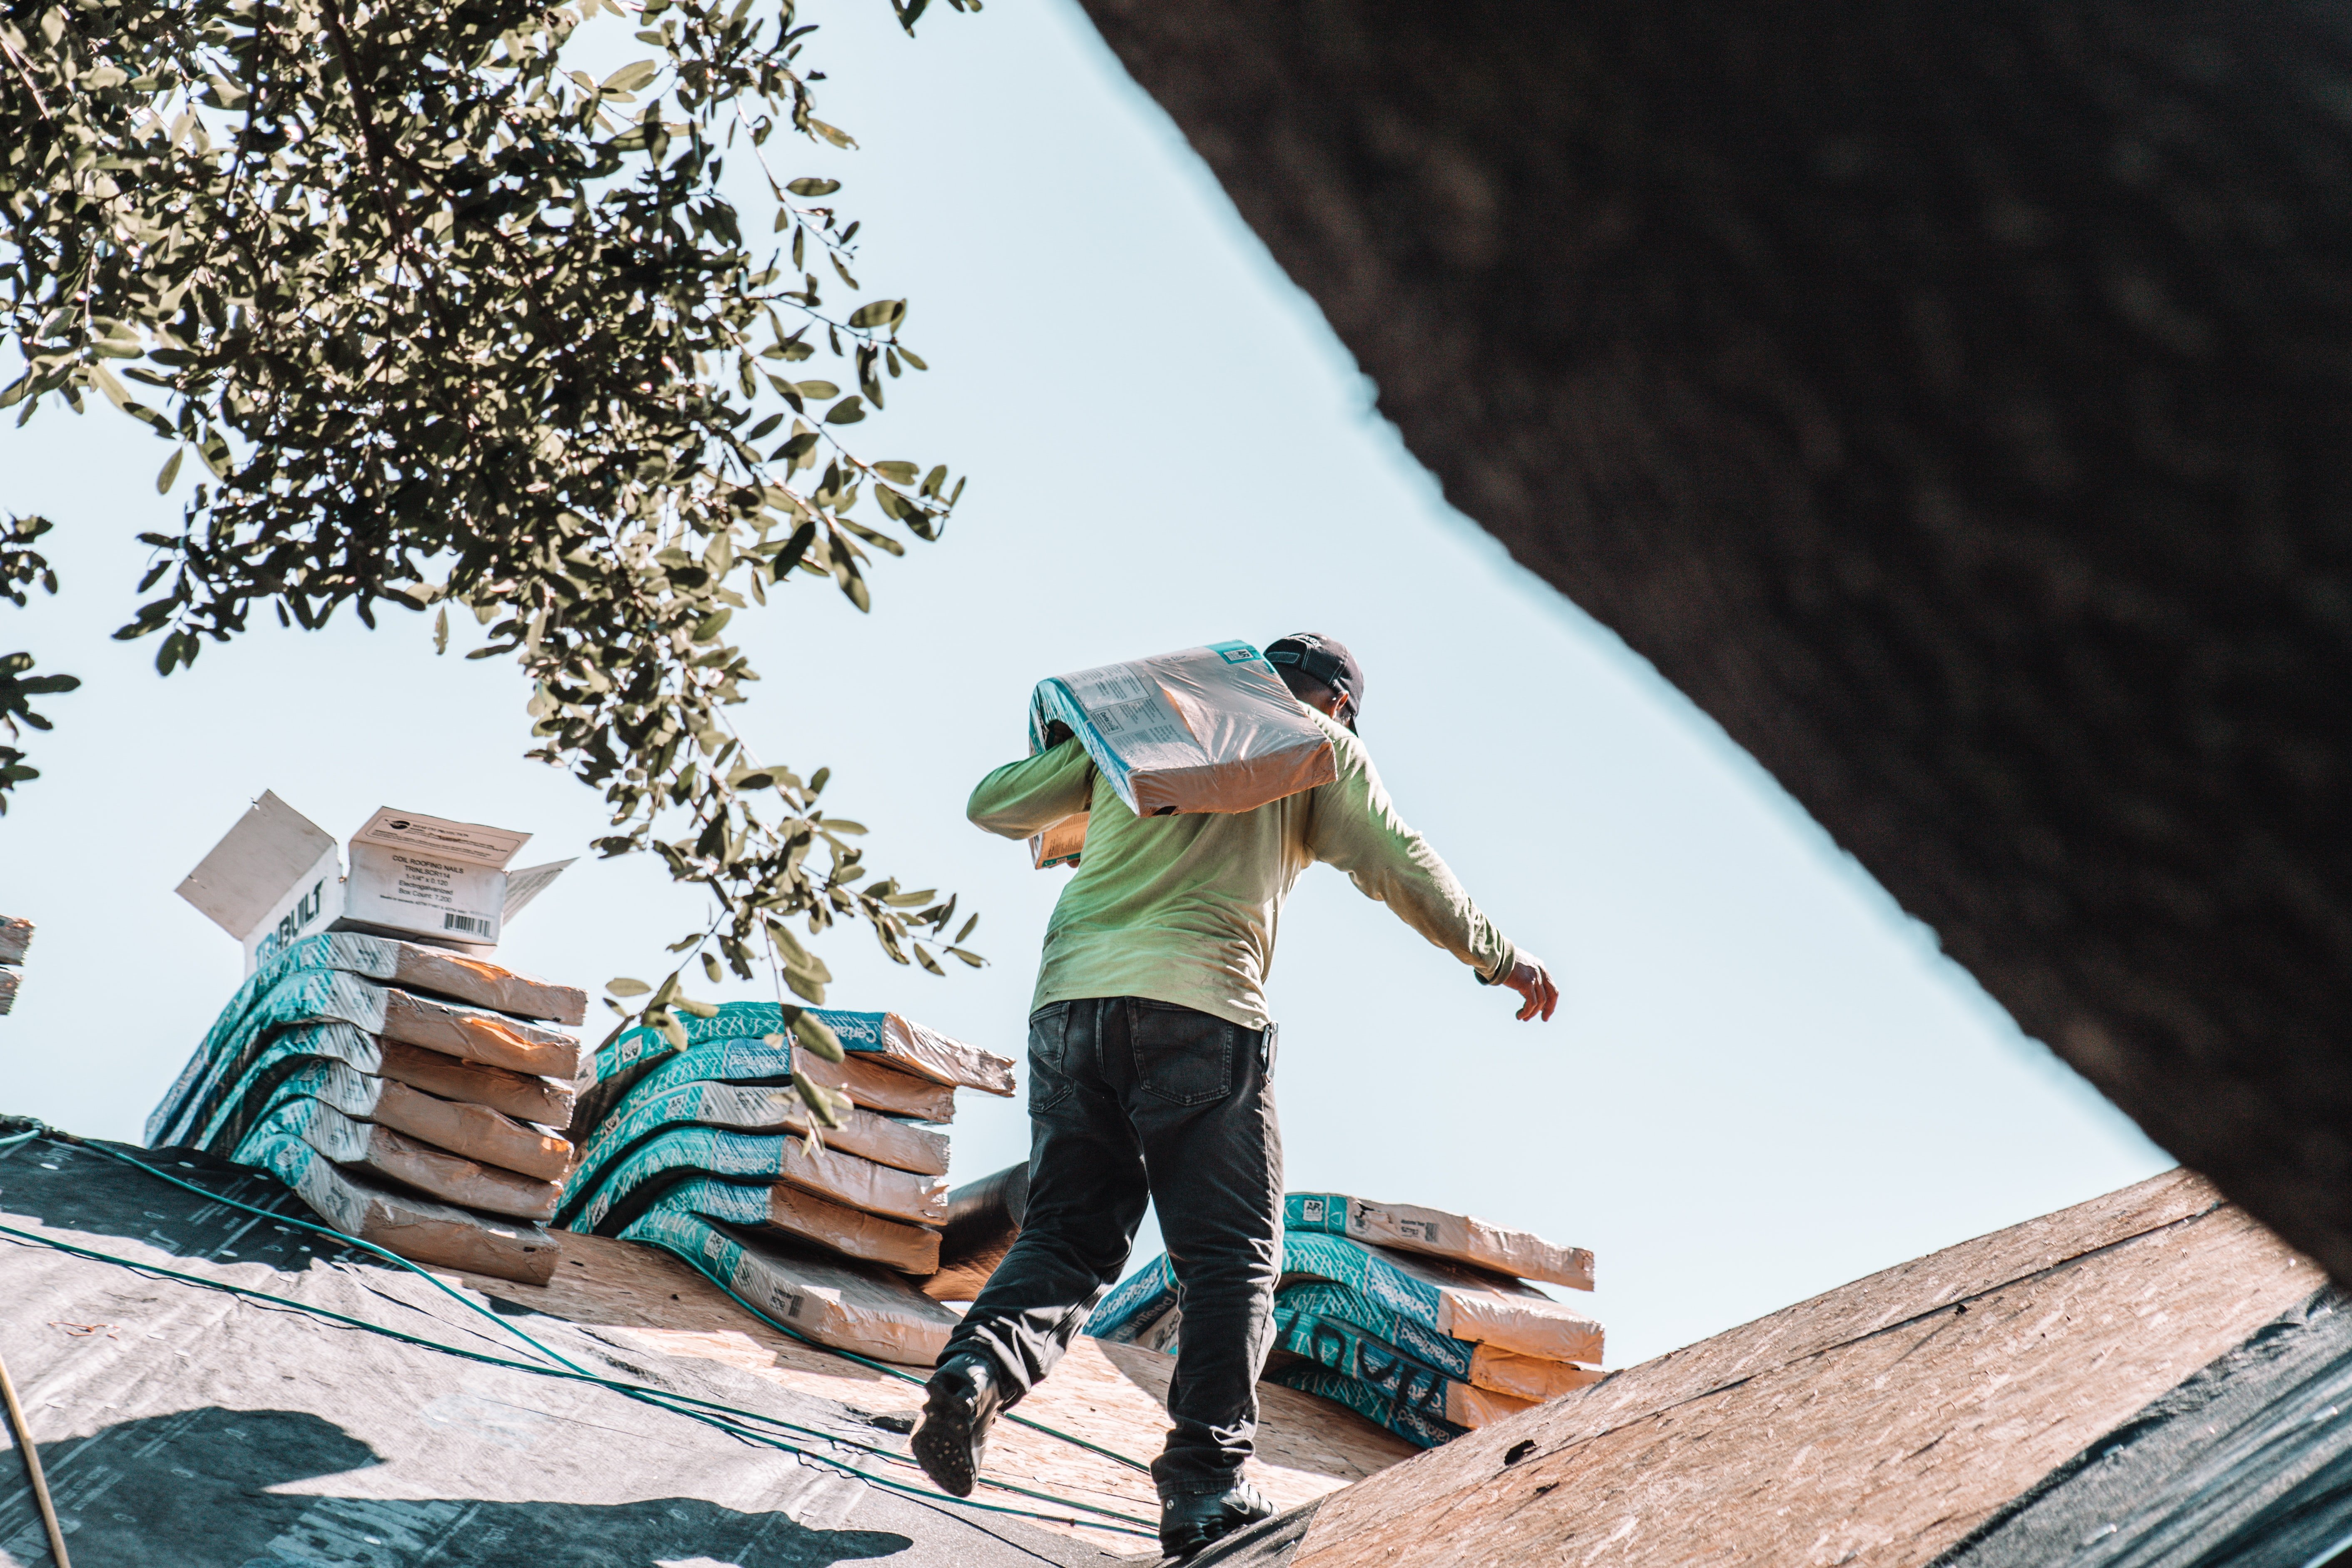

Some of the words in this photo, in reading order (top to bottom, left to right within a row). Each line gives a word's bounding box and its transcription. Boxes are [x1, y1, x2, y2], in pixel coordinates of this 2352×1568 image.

[392, 855, 408, 863] COIL
[410, 859, 442, 870] ROOFING
[444, 864, 464, 874] NAILS
[405, 865, 450, 879] TRINLSCR114
[399, 880, 453, 895] Electrogalvanized
[431, 878, 448, 886] 0.120
[1307, 1202, 1321, 1212] AR
[1086, 1268, 1158, 1328] CertainTeed
[1400, 1328, 1465, 1374] CertainTeed
